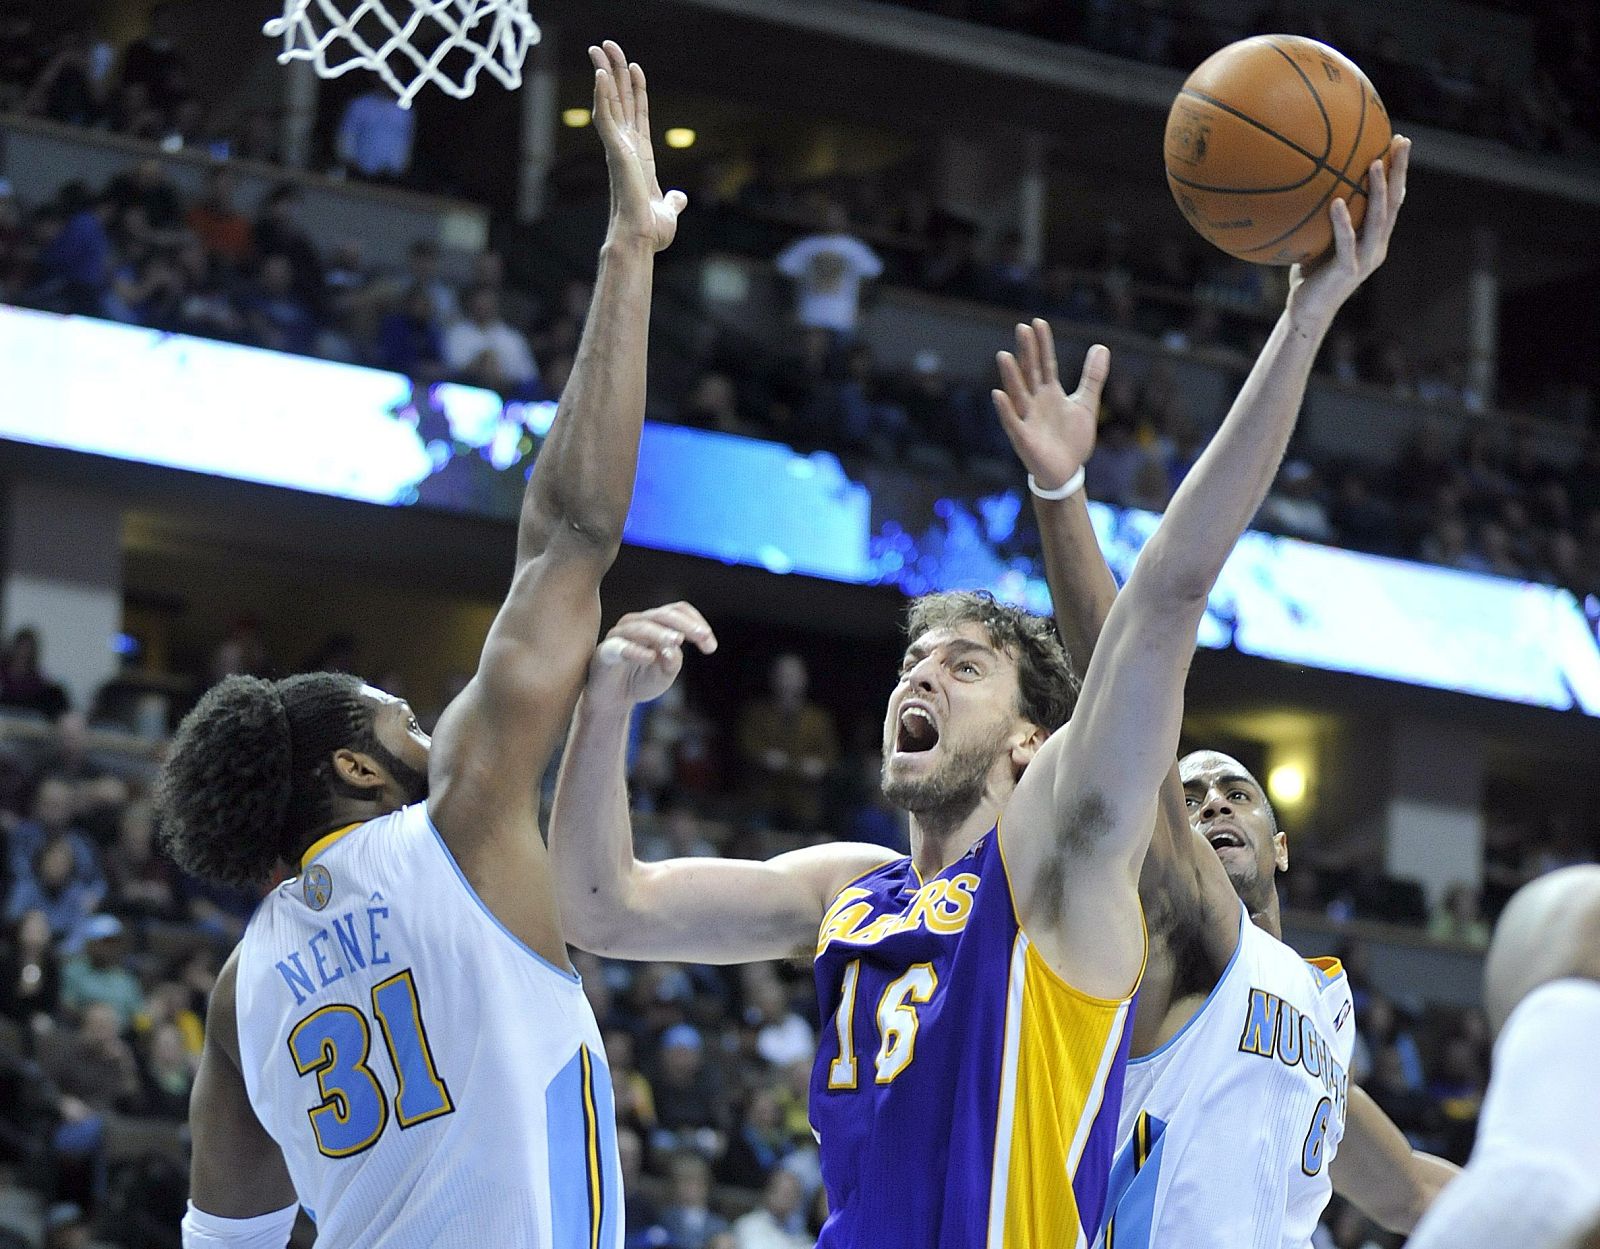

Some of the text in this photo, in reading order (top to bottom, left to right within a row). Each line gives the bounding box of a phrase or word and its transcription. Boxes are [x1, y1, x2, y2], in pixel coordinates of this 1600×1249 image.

[275, 892, 391, 1005] NENÊ
[815, 873, 981, 962] LARS
[287, 967, 455, 1158] 31
[828, 959, 938, 1089] 16
[1238, 987, 1347, 1126] NUGGT
[1302, 1097, 1332, 1176] 6
